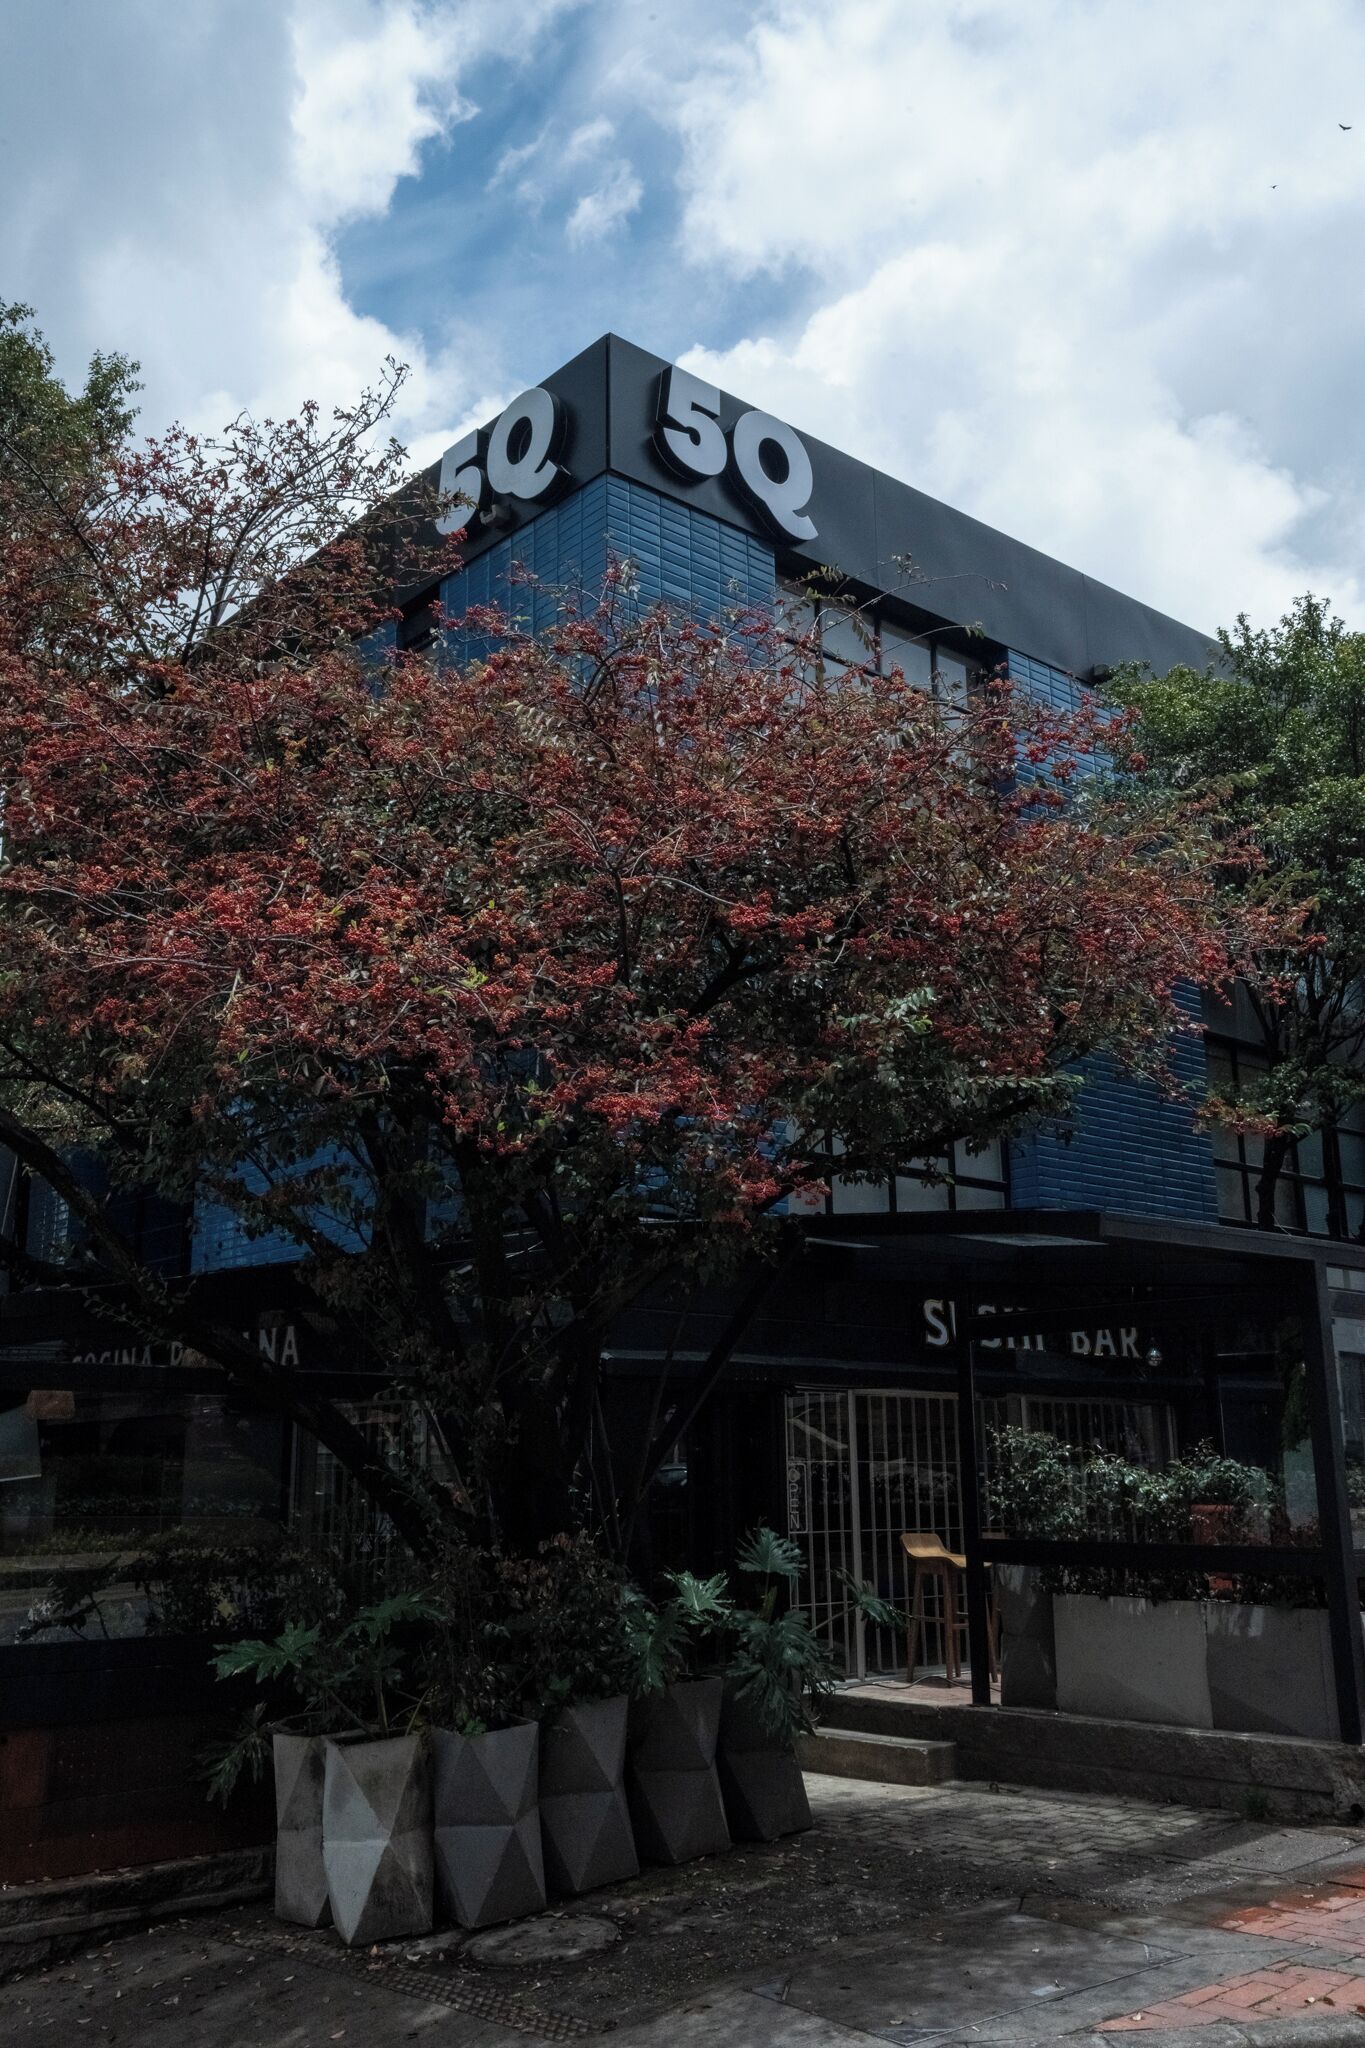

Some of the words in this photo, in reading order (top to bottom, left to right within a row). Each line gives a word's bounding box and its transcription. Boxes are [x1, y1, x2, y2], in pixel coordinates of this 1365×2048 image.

[435, 387, 560, 537] 5Q
[663, 365, 819, 541] 5Q
[788, 1468, 801, 1529] OPEN
